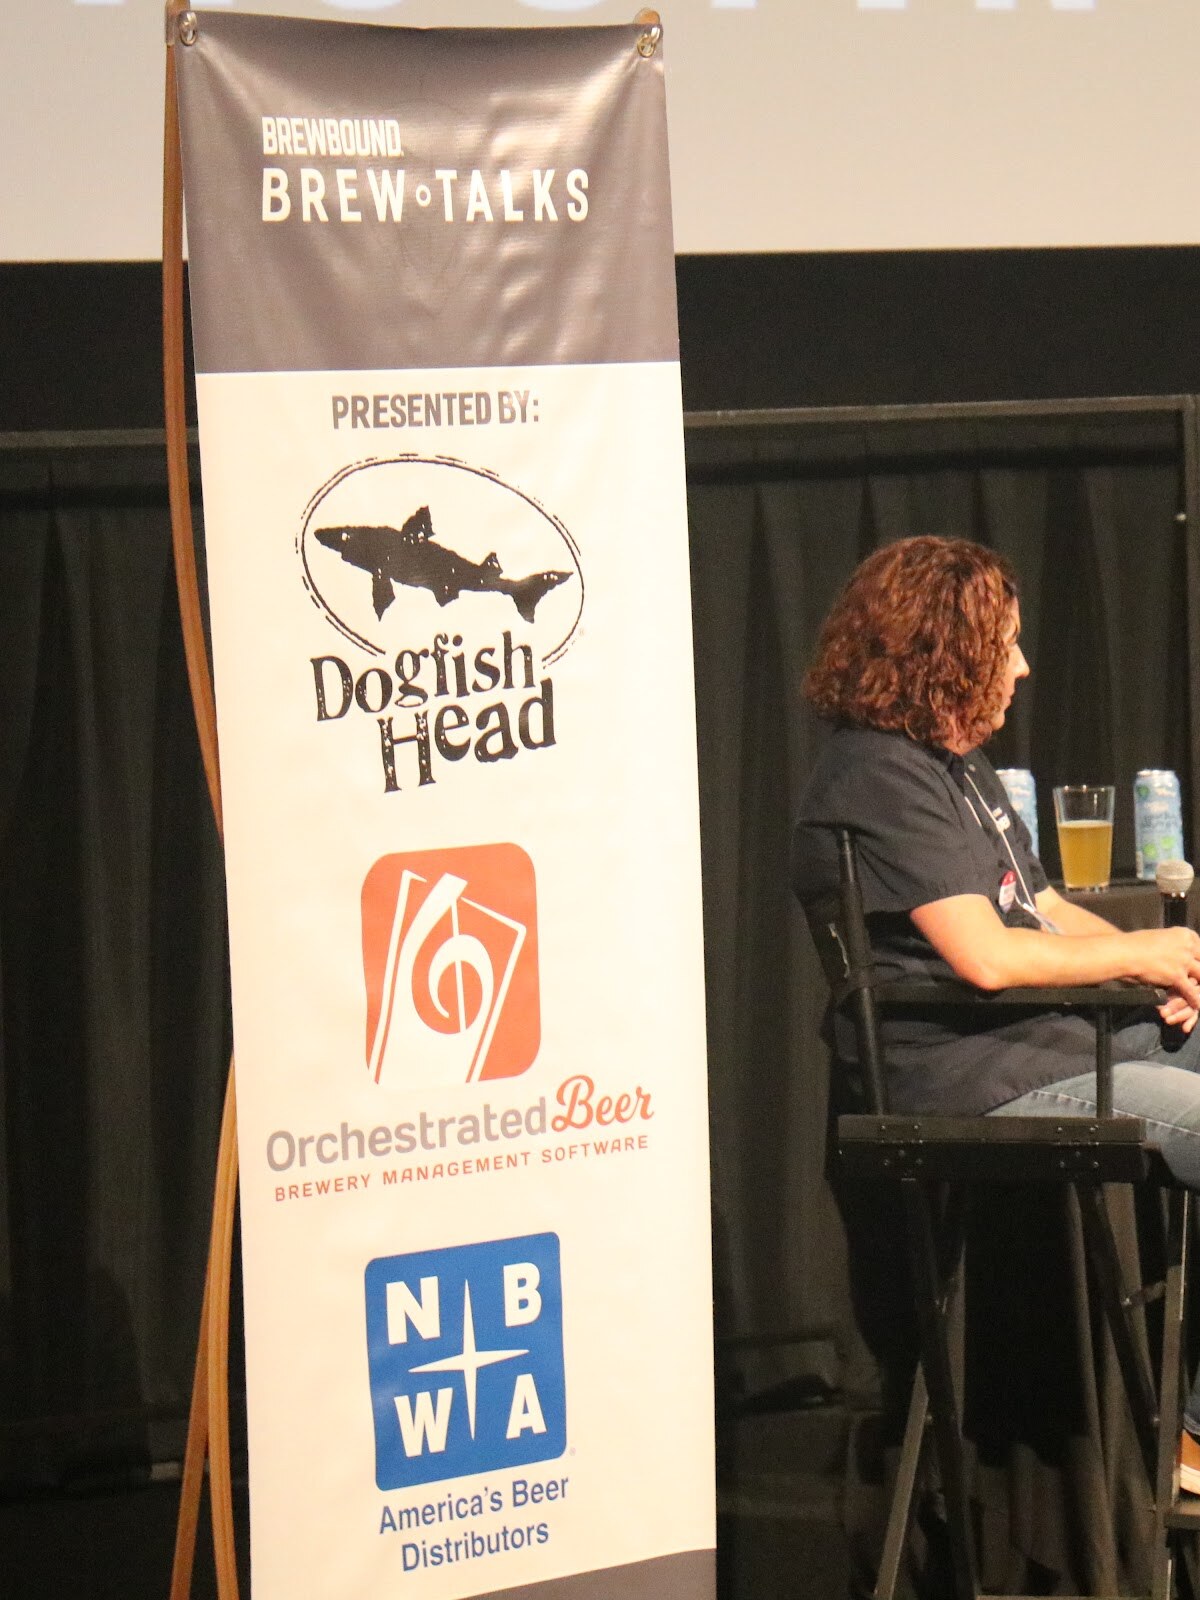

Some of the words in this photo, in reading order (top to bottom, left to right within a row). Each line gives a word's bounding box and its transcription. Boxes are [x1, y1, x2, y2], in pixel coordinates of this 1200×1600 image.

[331, 391, 492, 429] PRESENTED
[497, 390, 540, 425] BY:
[310, 630, 536, 722] Dogfish
[378, 677, 557, 793] Head
[275, 1172, 371, 1203] BREWERY
[382, 1151, 532, 1186] MANAGEMENT
[541, 1134, 650, 1164] SOFTWARE
[379, 1486, 502, 1535] America's
[512, 1476, 569, 1508] Beer
[401, 1520, 550, 1572] Distributors
